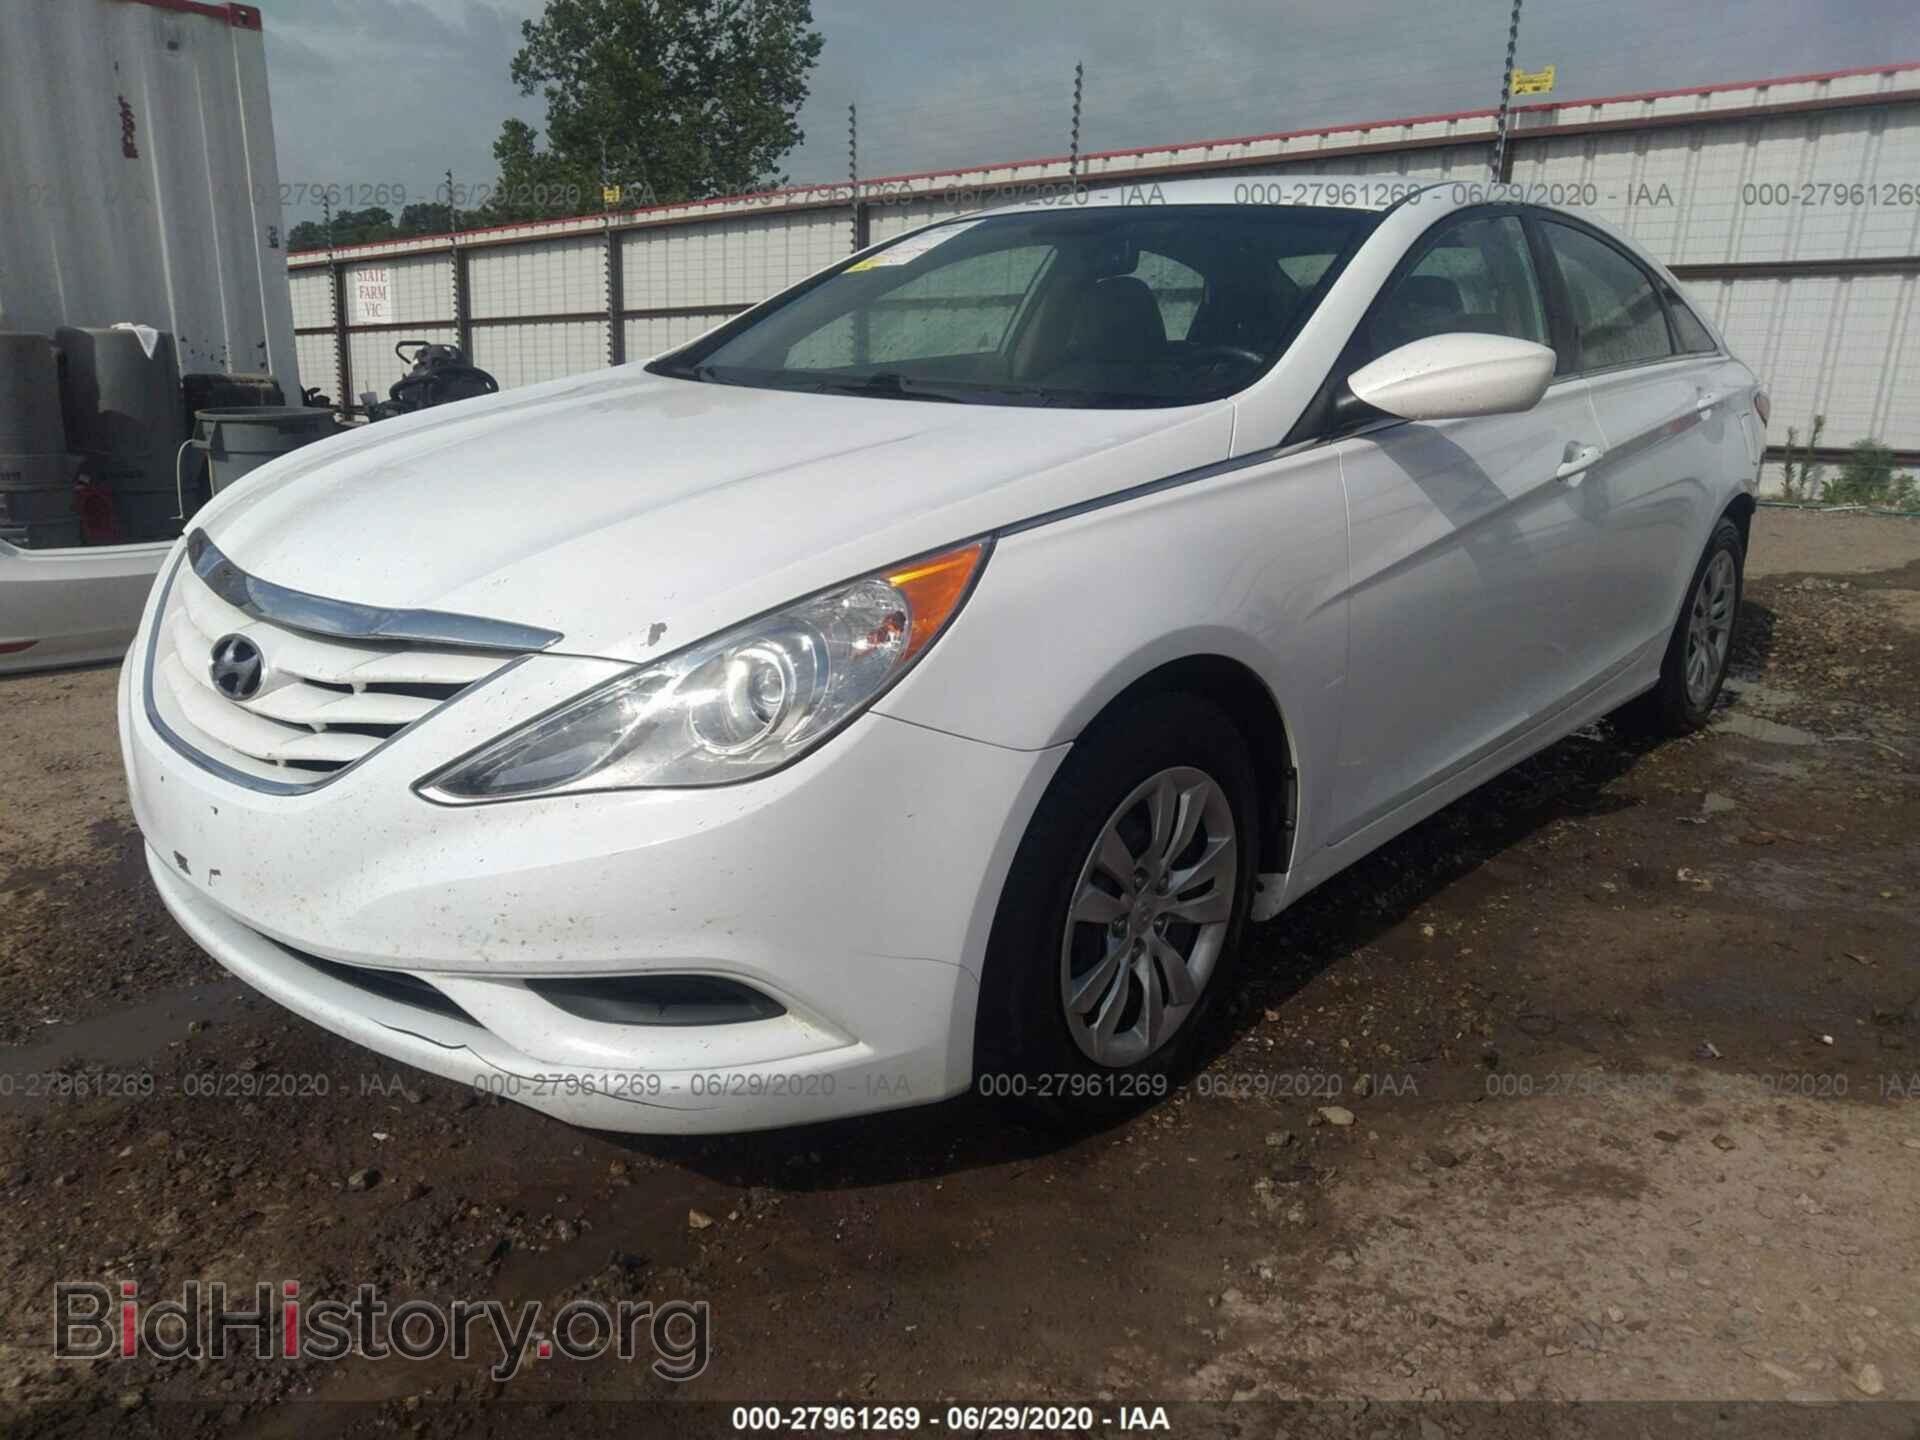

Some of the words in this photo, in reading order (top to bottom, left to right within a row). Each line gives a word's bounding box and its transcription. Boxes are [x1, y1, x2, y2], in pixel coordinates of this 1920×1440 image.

[356, 268, 387, 282] STATE
[359, 285, 386, 300] FARM
[364, 302, 382, 318] VIC
